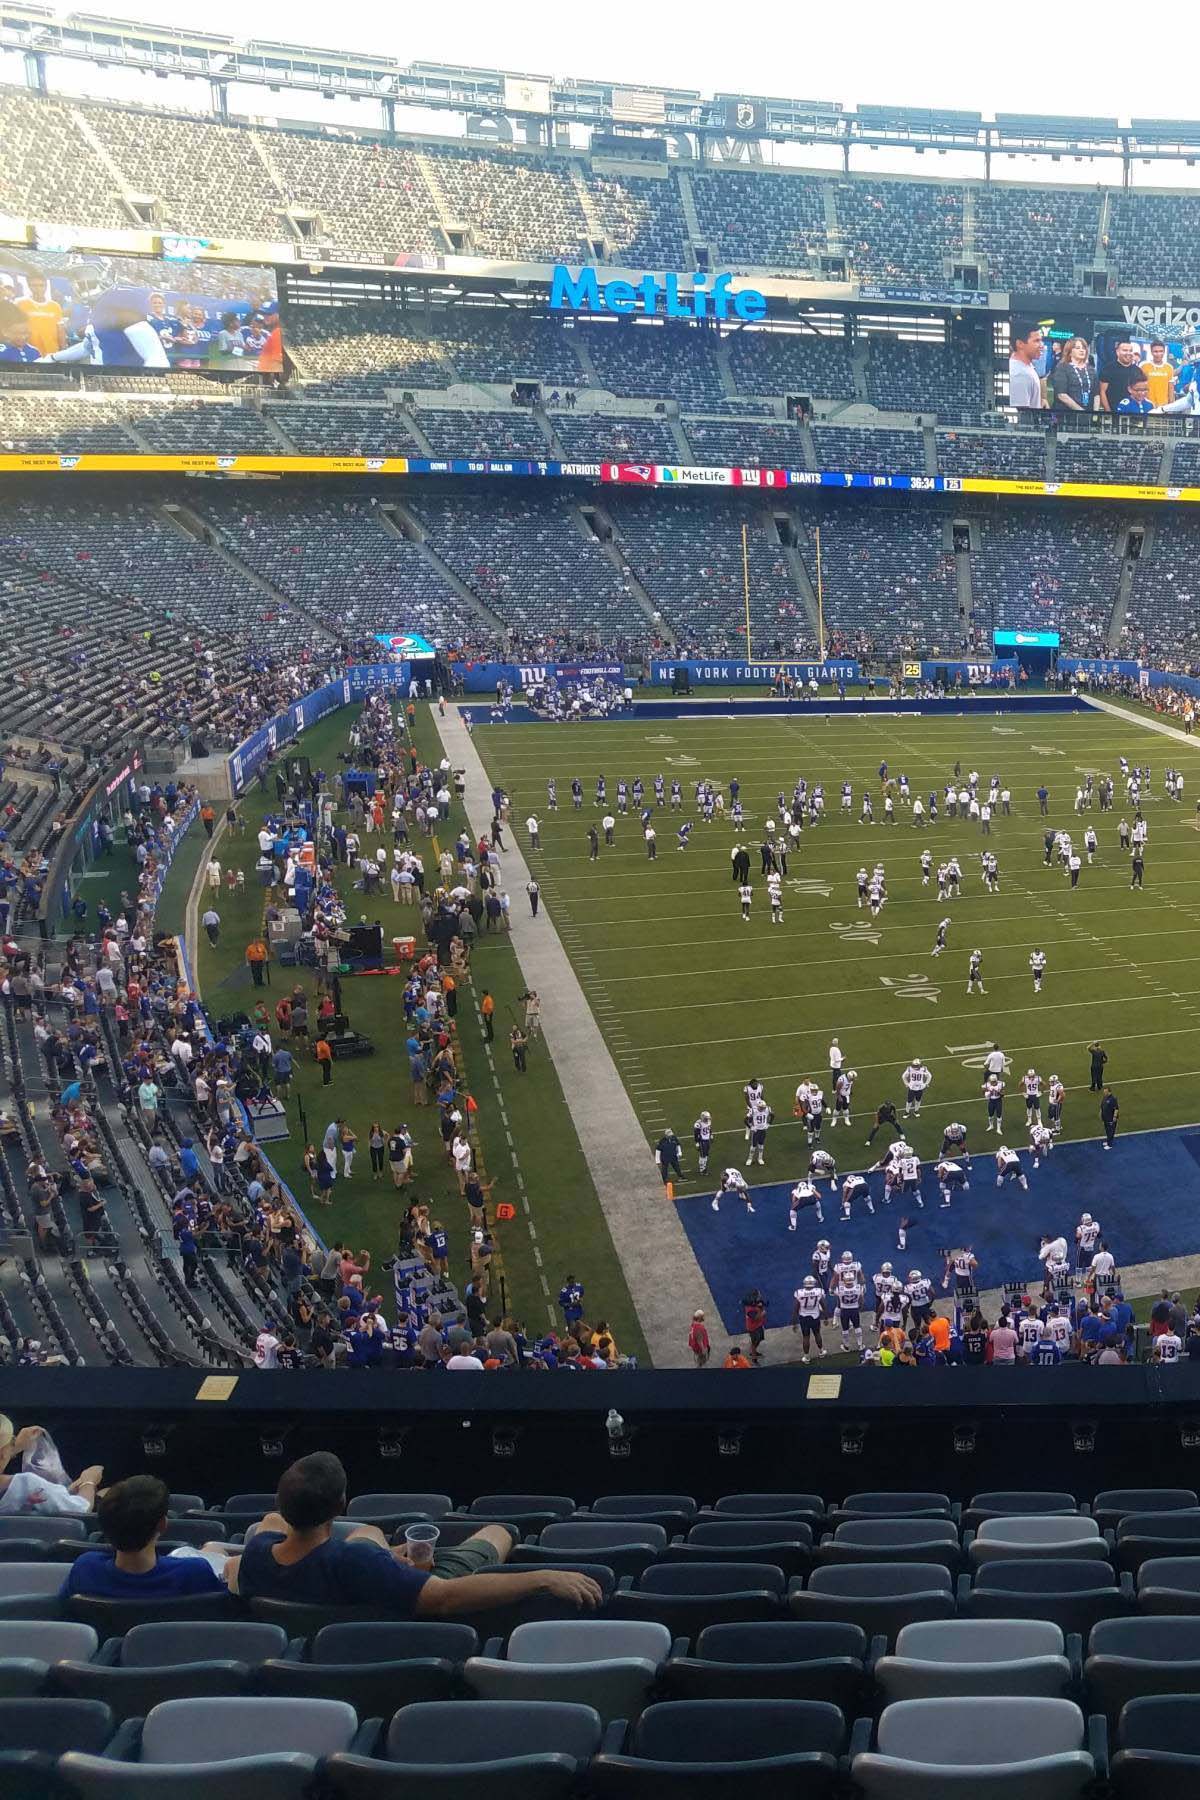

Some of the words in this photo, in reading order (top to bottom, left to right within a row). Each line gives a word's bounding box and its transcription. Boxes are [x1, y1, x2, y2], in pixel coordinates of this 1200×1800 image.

[551, 265, 768, 320] MetLife
[60, 457, 79, 469] SAP
[561, 464, 601, 475] PATRIOTS
[610, 465, 619, 479] 0
[682, 470, 726, 482] MetLife
[767, 472, 775, 485] 0
[790, 472, 821, 483] GIANTS
[910, 477, 935, 489] 36:34
[950, 480, 958, 489] 25
[696, 668, 729, 679] YORK
[807, 667, 854, 679] GIANTS
[905, 665, 920, 676] 25
[880, 973, 941, 999] 20
[907, 1162, 914, 1173] 2
[500, 1206, 510, 1218] G
[436, 1236, 446, 1248] 13
[842, 1296, 859, 1304] 62
[912, 1289, 929, 1301] 69
[801, 1297, 819, 1309] 77
[1024, 1329, 1038, 1343] 13
[1054, 1329, 1066, 1342] 13
[394, 1336, 407, 1350] 26
[968, 1343, 981, 1353] 12
[1161, 1345, 1176, 1359] 13
[1038, 1353, 1054, 1366] 10
